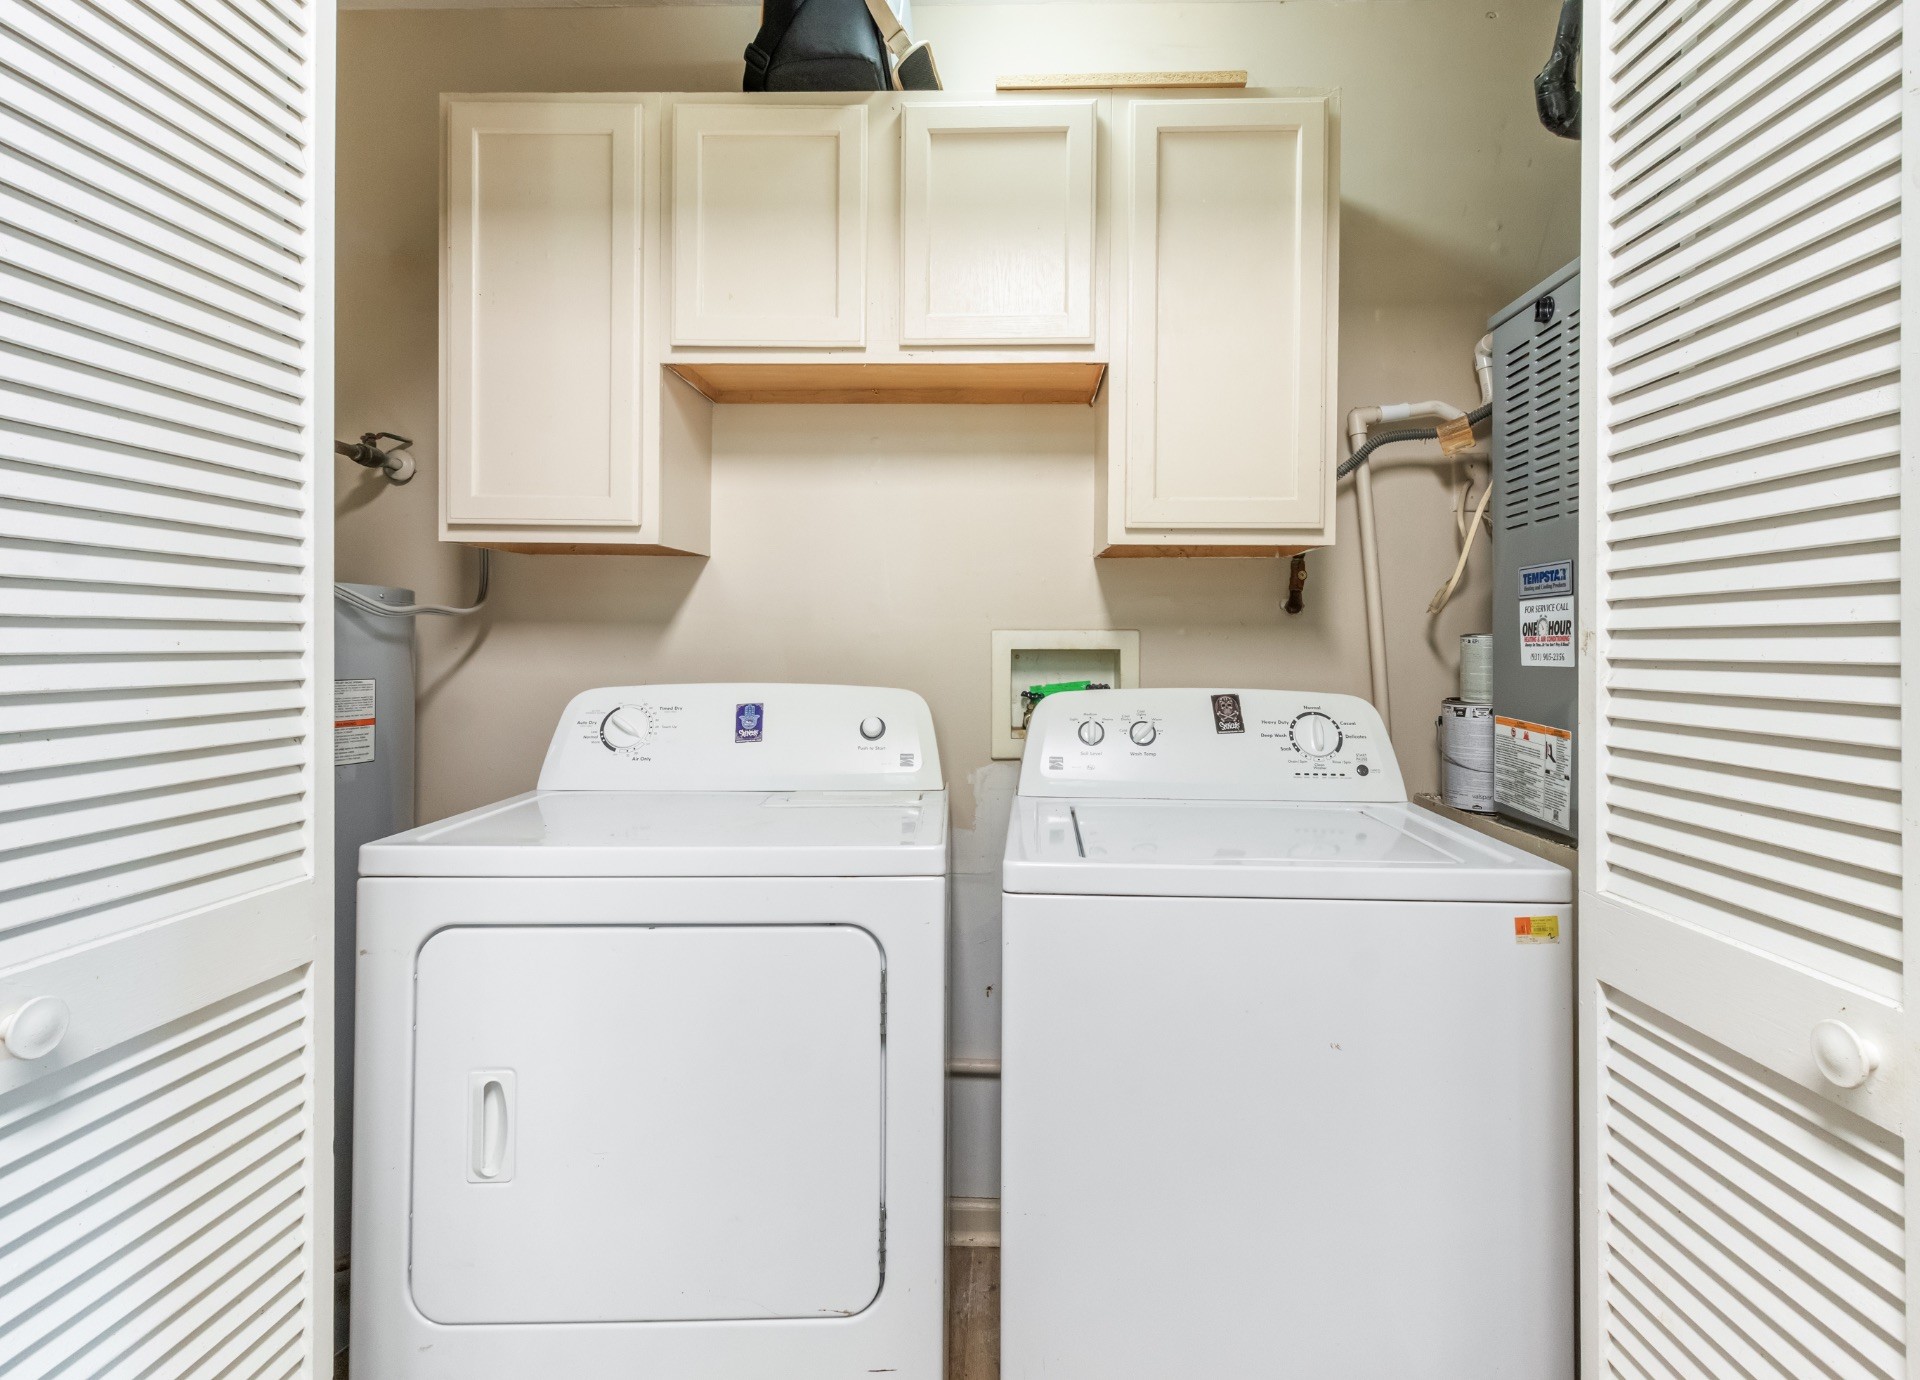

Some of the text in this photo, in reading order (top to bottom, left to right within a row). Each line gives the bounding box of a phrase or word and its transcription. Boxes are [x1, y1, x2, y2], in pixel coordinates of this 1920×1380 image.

[1523, 568, 1567, 585] TEMPSTAR
[1524, 602, 1569, 613] FOR SERVICE CALL
[1522, 620, 1572, 636] ONE HOUR
